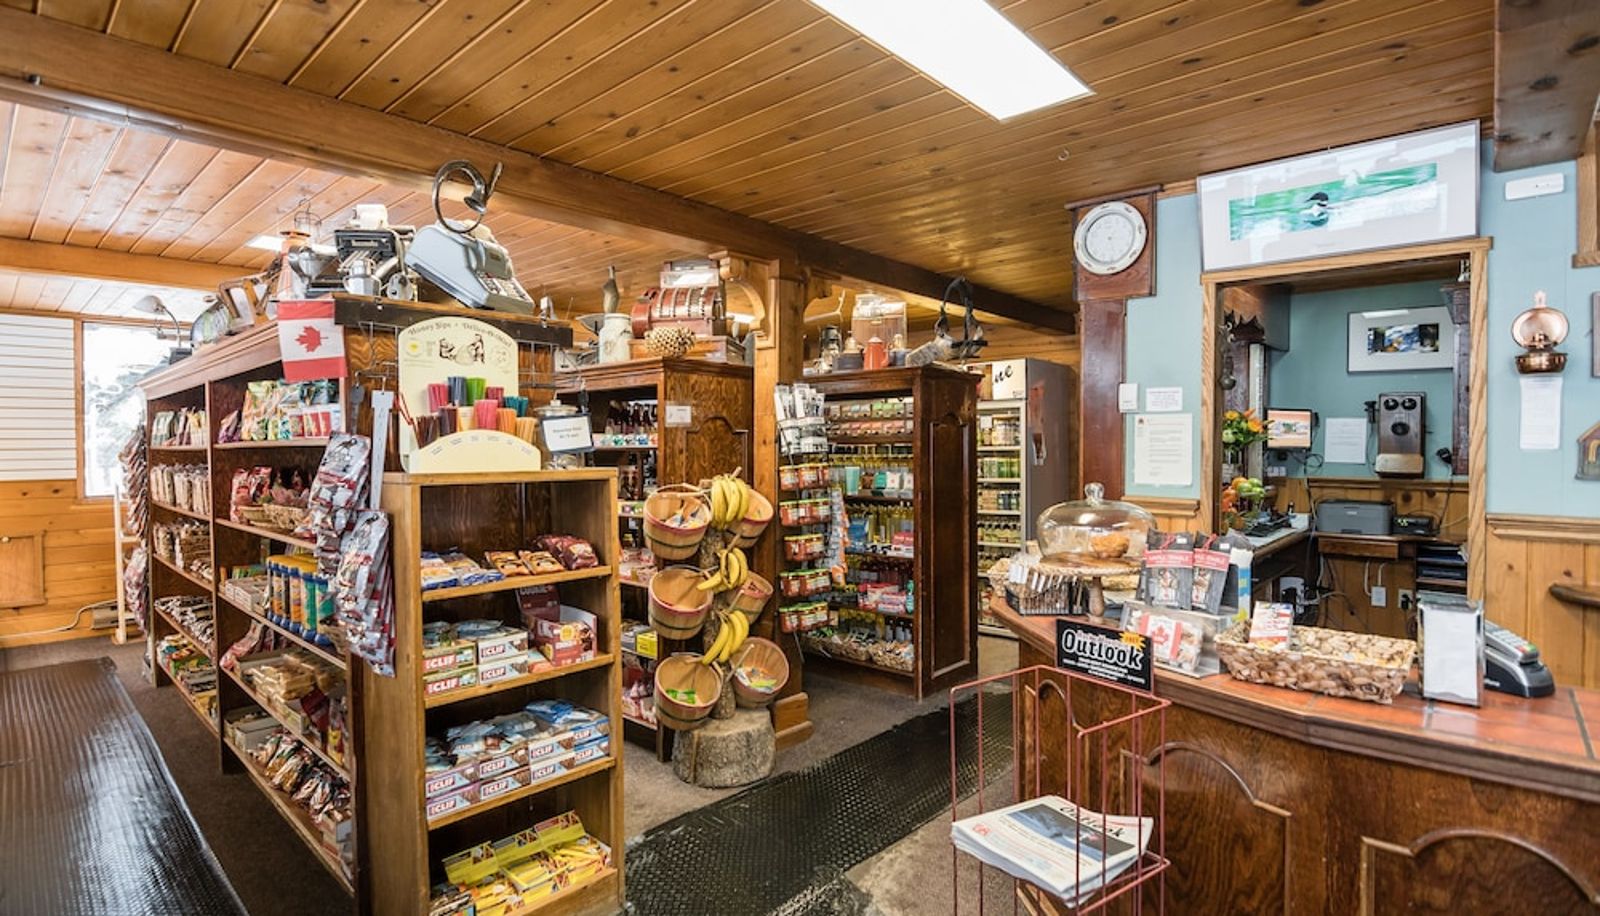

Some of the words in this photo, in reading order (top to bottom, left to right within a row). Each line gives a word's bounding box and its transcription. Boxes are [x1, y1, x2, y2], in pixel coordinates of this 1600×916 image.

[486, 644, 505, 656] CLIF
[1062, 628, 1145, 670] Outlook
[430, 654, 456, 667] CLIF
[487, 668, 505, 678] CLIF
[433, 678, 460, 692] CLIF
[536, 744, 554, 756] CLIF
[488, 760, 506, 771] CLIF
[539, 765, 555, 777] CLIF
[434, 777, 455, 791] CLIF
[490, 782, 508, 794] CLIF
[435, 800, 456, 813] CLIF
